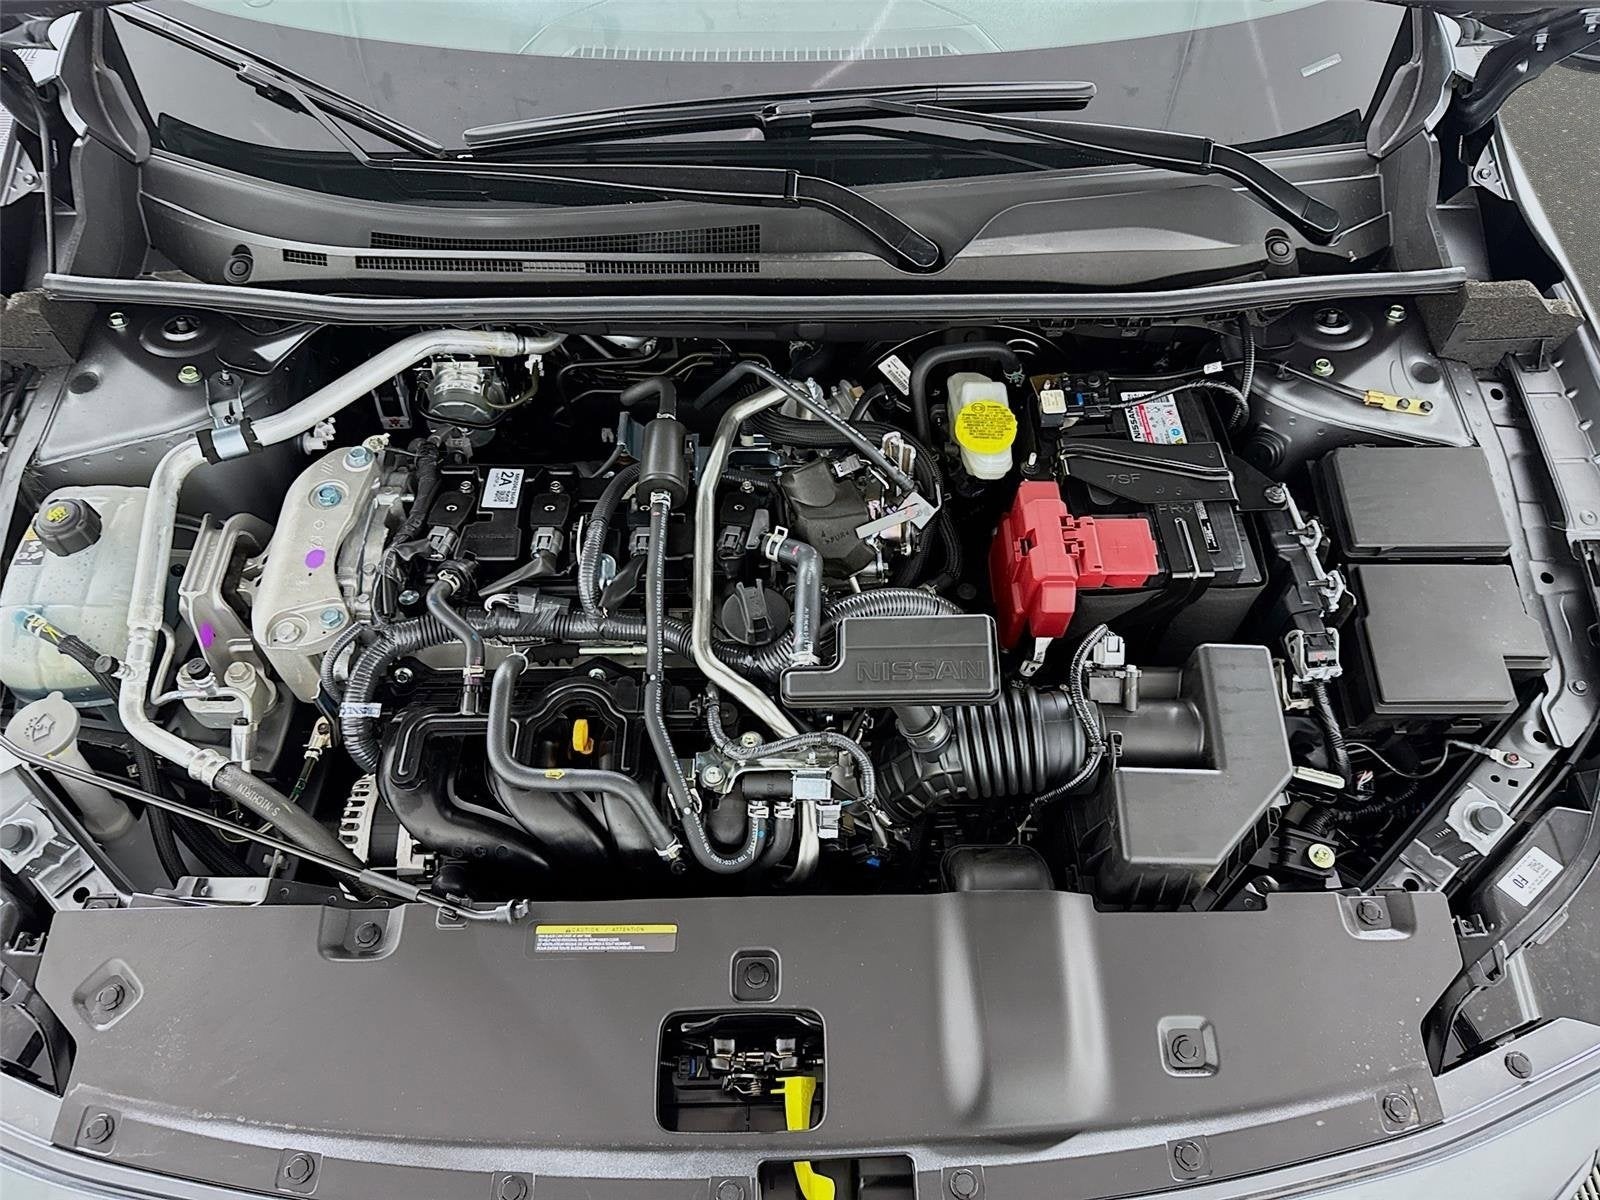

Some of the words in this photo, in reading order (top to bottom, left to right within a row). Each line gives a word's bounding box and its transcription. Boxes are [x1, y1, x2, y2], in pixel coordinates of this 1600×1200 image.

[1127, 405, 1141, 439] NISSAN
[499, 471, 515, 487] 2A
[1106, 473, 1141, 484] 7SF
[857, 660, 985, 681] NISSAN
